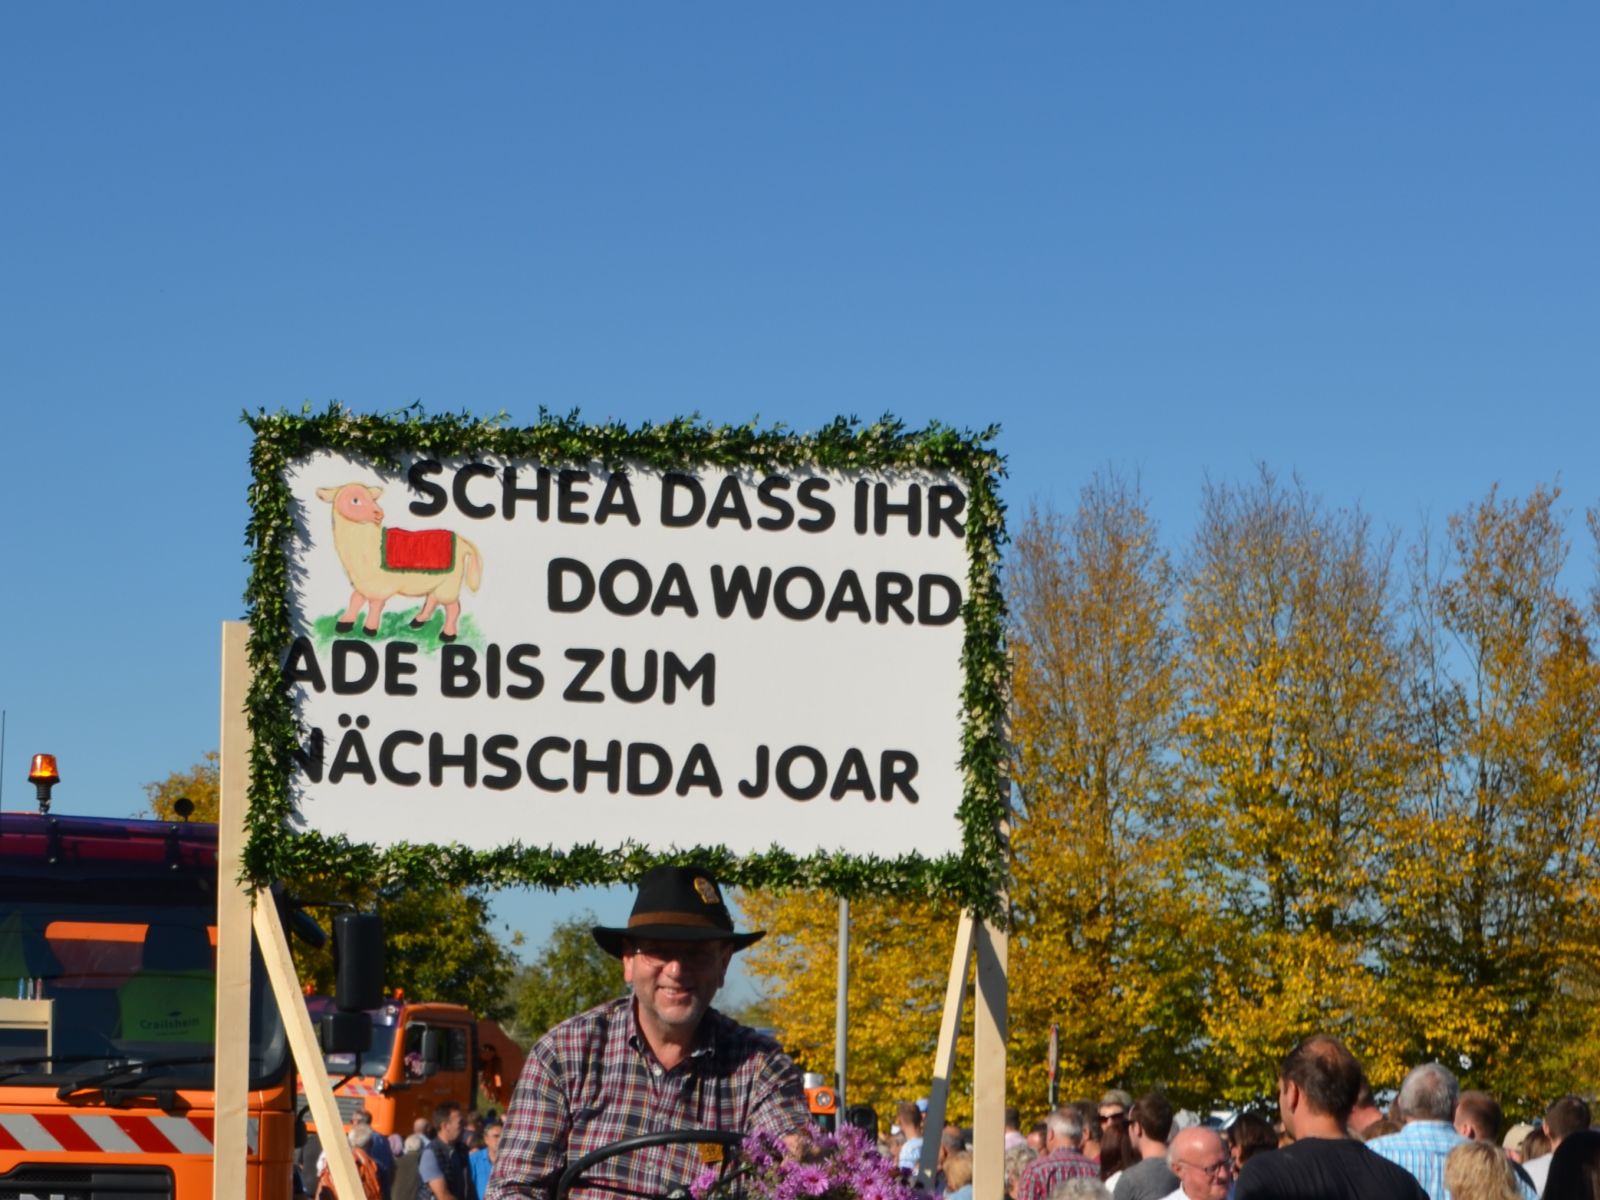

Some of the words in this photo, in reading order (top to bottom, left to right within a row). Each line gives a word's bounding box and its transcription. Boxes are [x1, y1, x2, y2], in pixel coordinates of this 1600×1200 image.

[407, 459, 641, 527] SCHEA
[660, 473, 837, 533] DASS
[853, 480, 967, 539] IHR
[546, 557, 699, 617] DOA
[710, 564, 964, 626] WOARD
[281, 636, 418, 696] ADE
[440, 644, 545, 700] BIS
[562, 648, 716, 706] ZUM
[738, 745, 919, 804] JOAR
